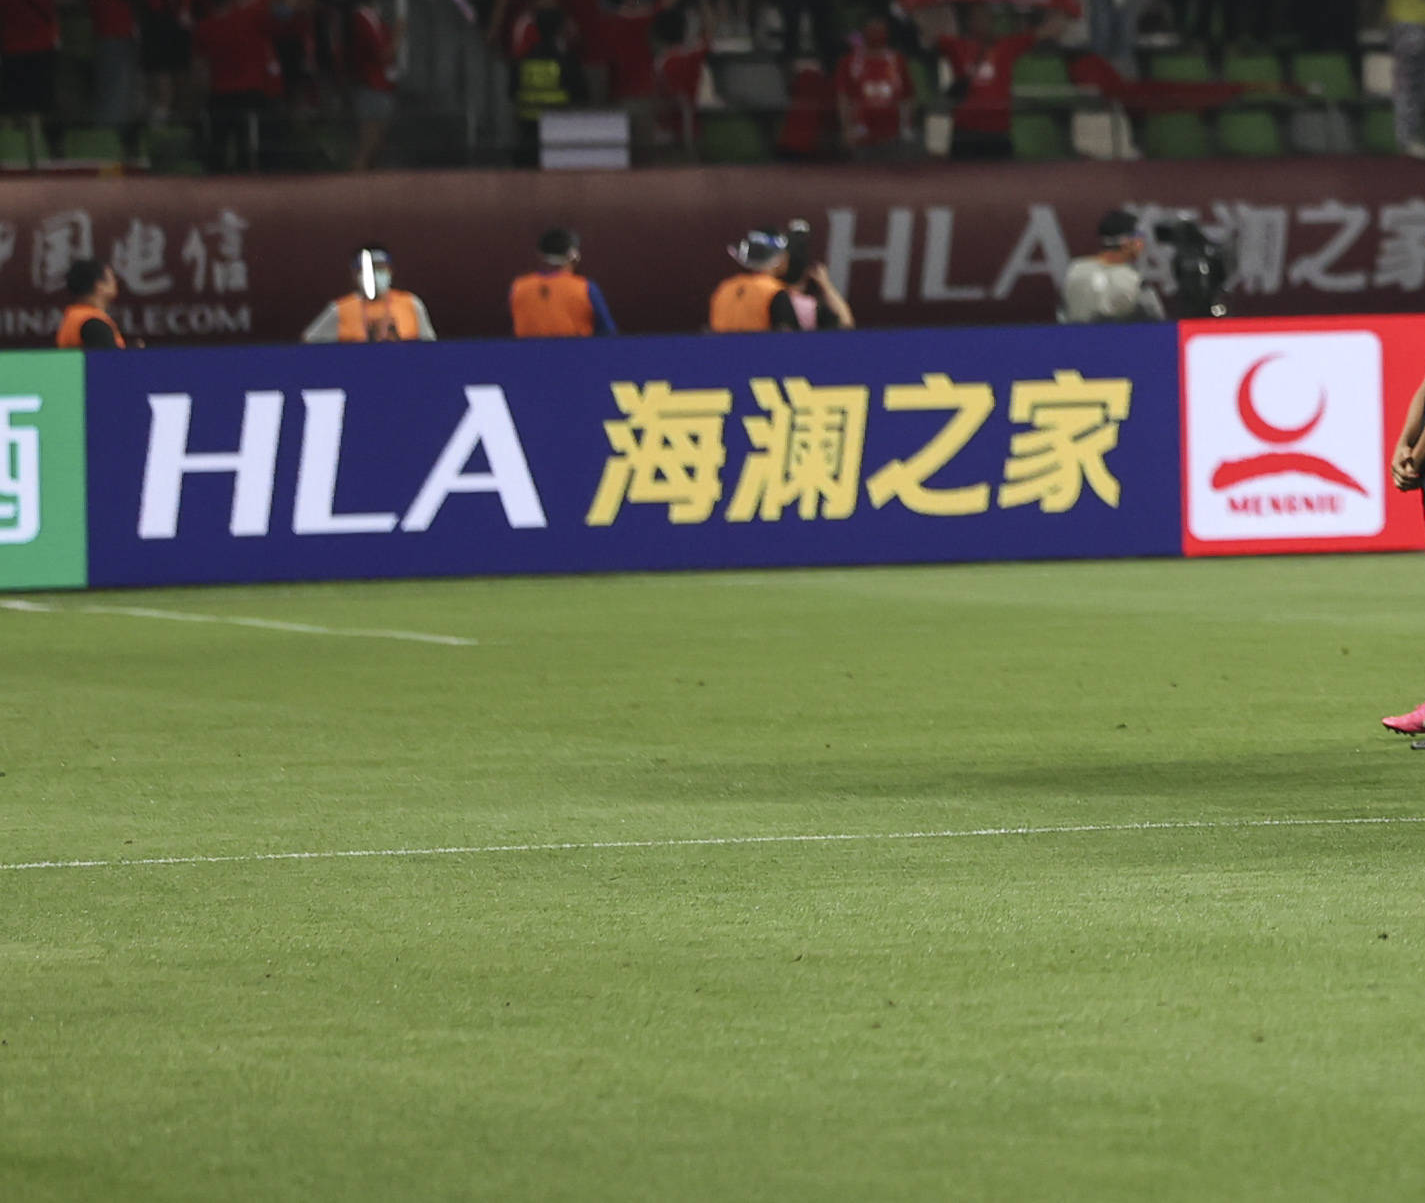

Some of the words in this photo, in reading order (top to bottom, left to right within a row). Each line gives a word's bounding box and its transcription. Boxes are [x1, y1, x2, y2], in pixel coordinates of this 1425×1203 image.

[0, 209, 249, 294] 国电信
[827, 205, 1072, 301] HLA
[137, 384, 548, 539] HLA
[585, 369, 1132, 526] 海澜之家
